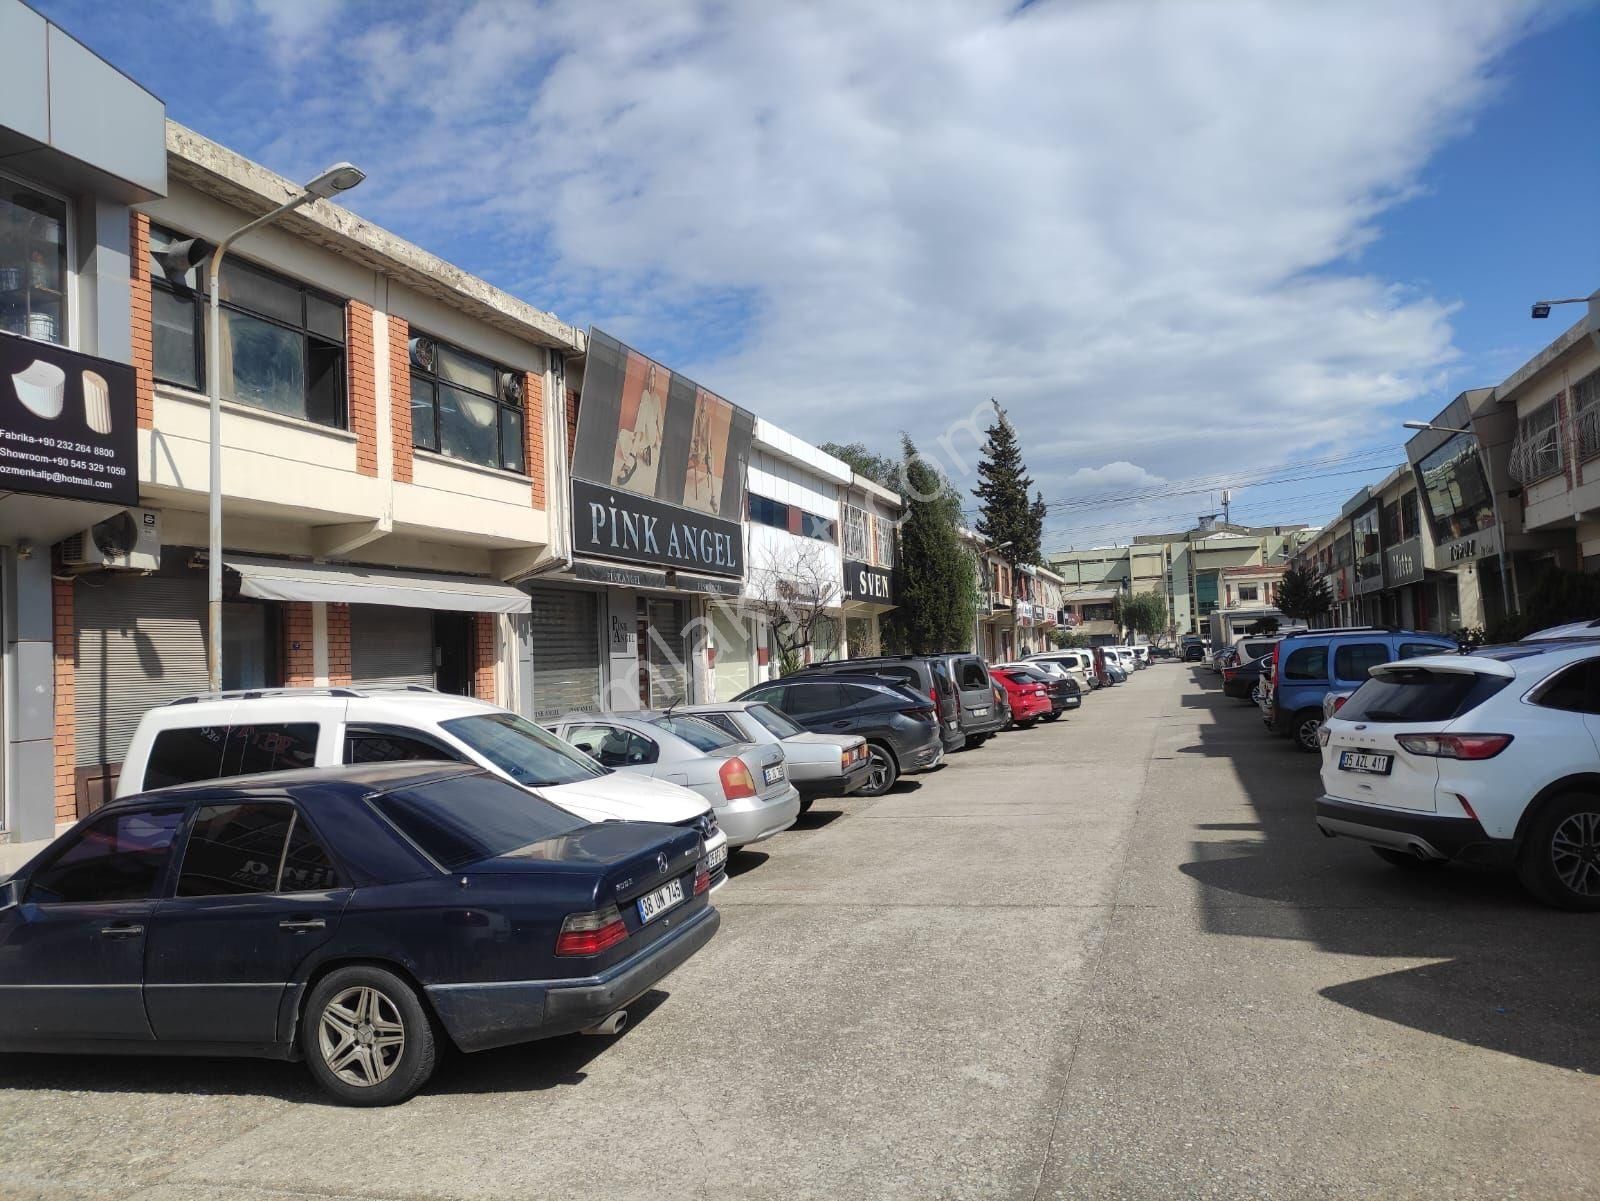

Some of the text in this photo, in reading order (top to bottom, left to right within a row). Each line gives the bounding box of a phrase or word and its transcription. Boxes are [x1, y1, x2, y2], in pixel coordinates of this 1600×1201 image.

[56, 439, 74, 451] 232
[75, 443, 92, 453] 264
[0, 465, 113, 489] ozmenkalip@hotmail.com
[70, 459, 87, 470] 545
[88, 462, 104, 472] 329
[106, 465, 126, 476] 1059
[667, 521, 736, 568] ANGEL
[859, 570, 889, 598] SVEN
[1344, 754, 1386, 770] 35 AZL 411
[654, 890, 666, 909] UN
[665, 882, 681, 902] 745
